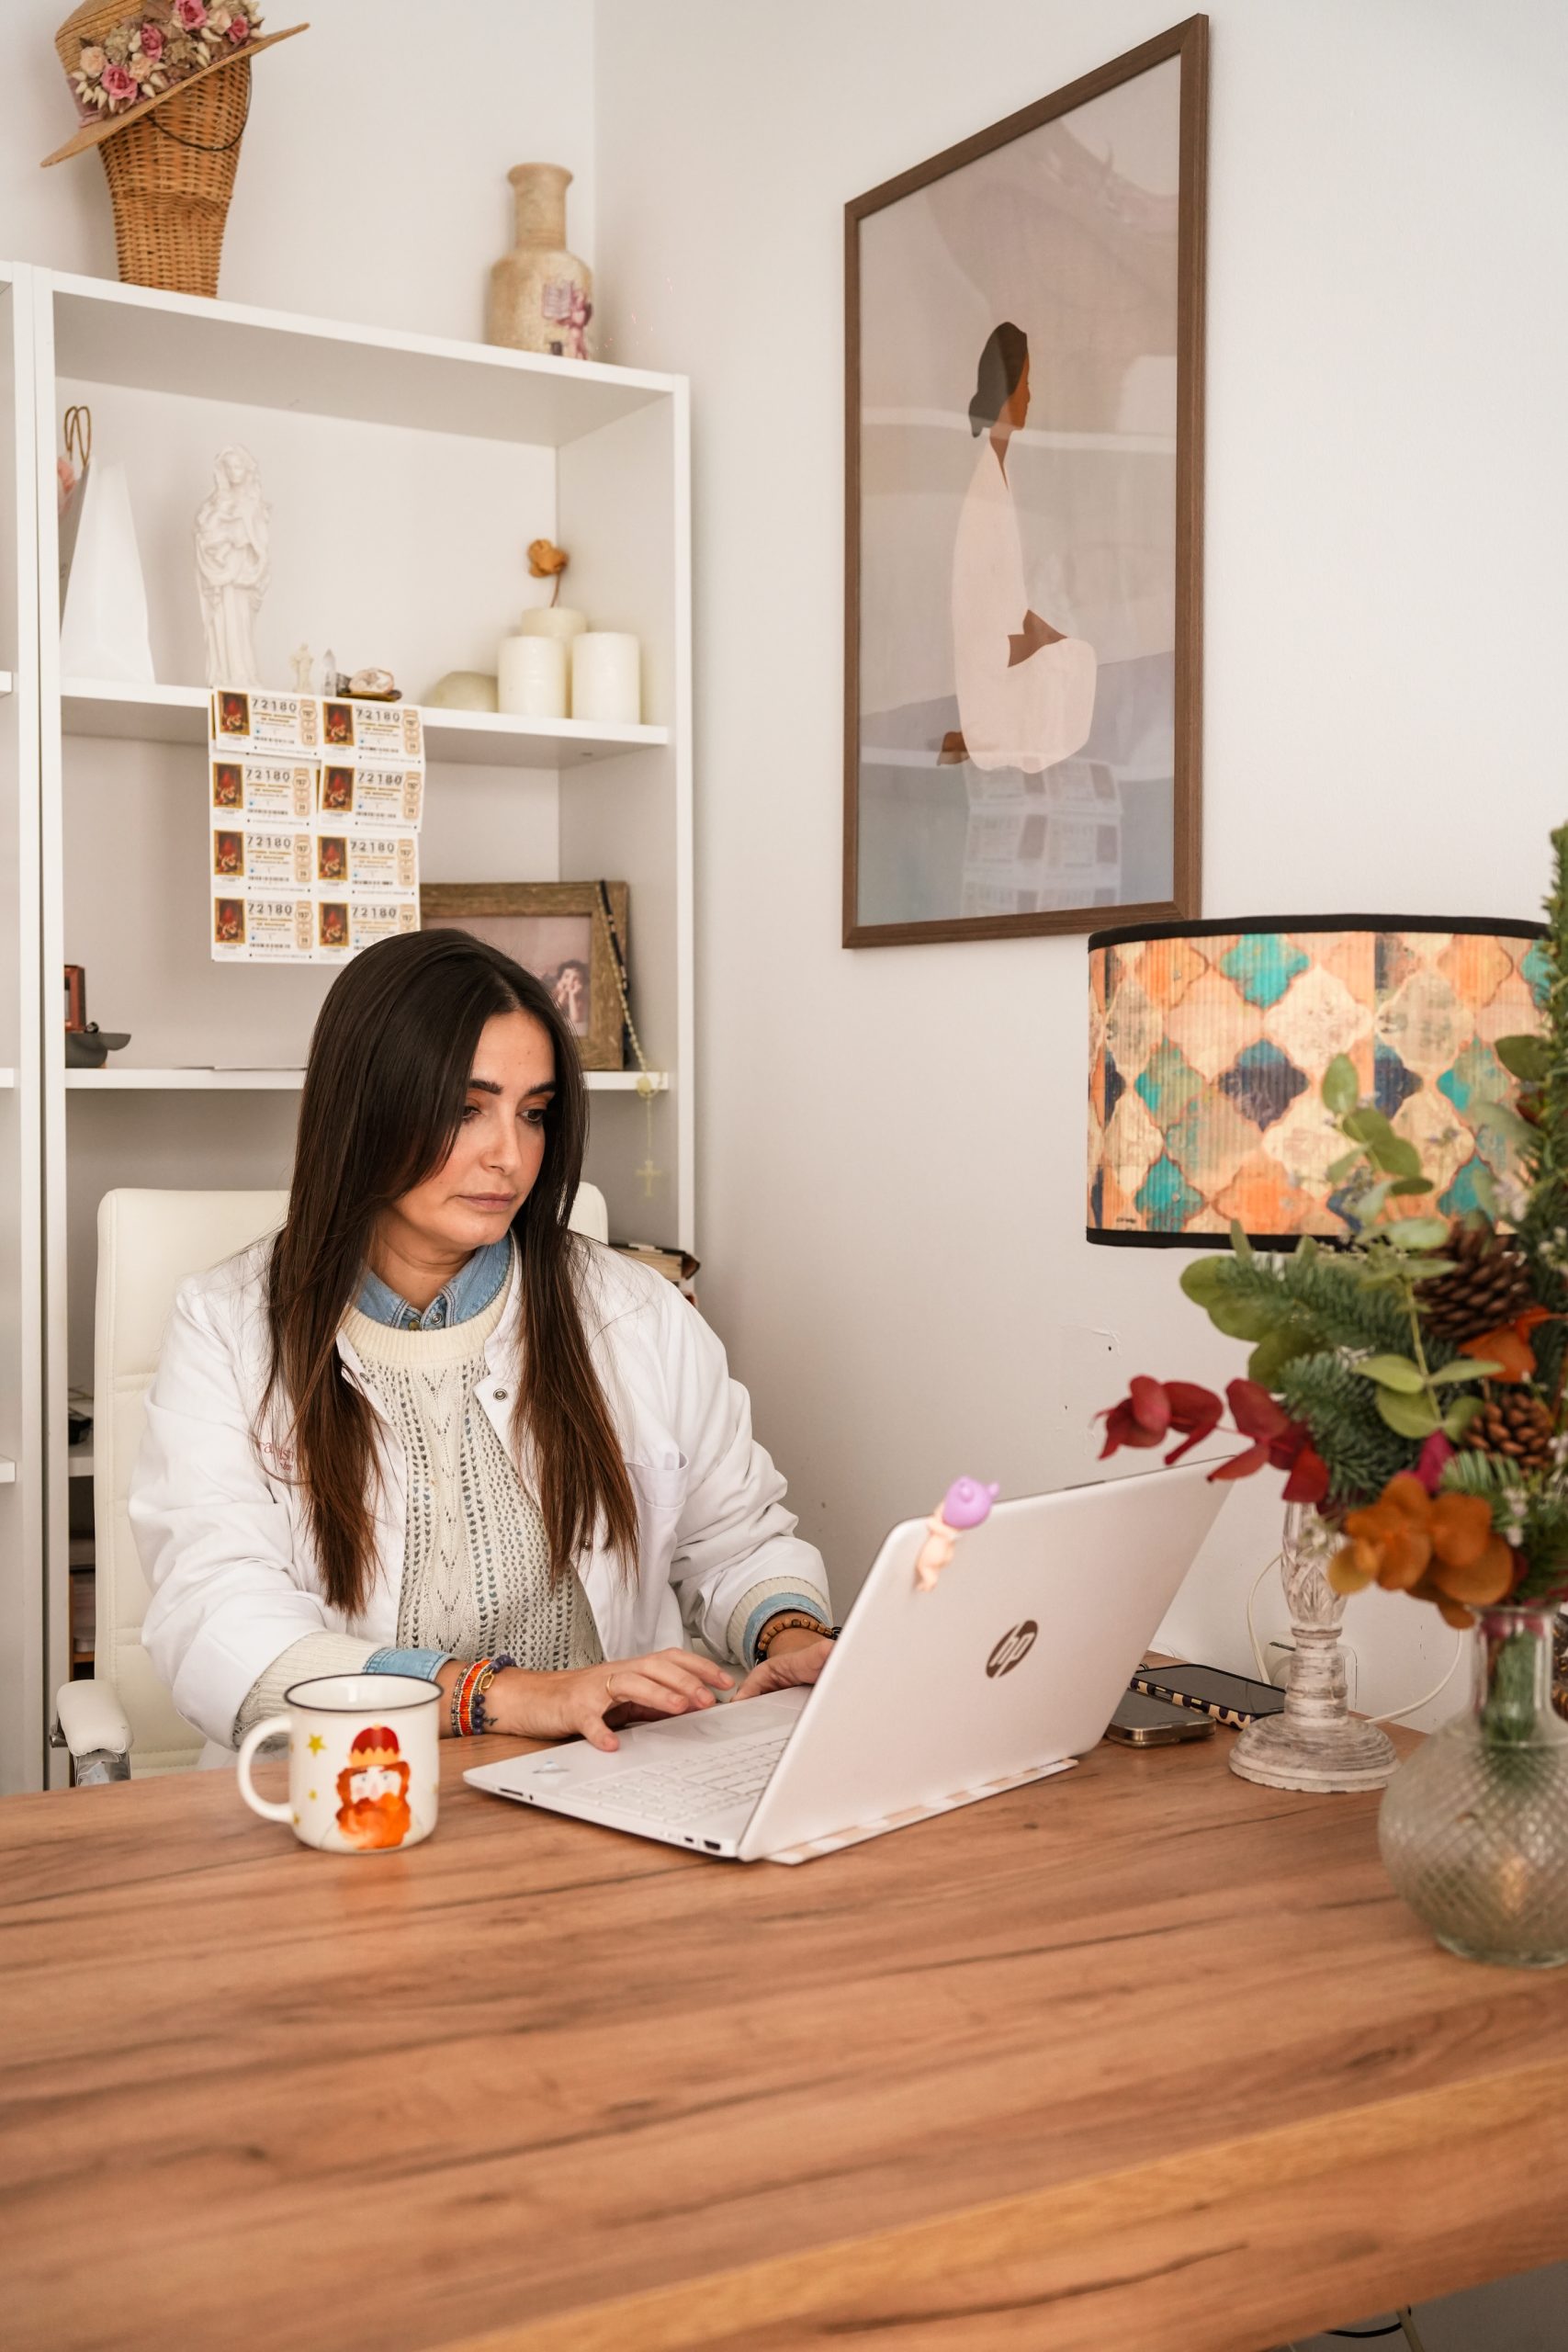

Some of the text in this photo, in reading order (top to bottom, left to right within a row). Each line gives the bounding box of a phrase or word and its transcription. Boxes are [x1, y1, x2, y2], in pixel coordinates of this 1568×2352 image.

[252, 697, 297, 713] 72180
[356, 708, 400, 722] 72180
[246, 769, 290, 782] 72180
[358, 772, 402, 786] 72180
[247, 836, 291, 849] 72180
[351, 841, 395, 854] 72180
[248, 902, 292, 915] 72180
[353, 906, 397, 918] 72180
[987, 1621, 1037, 1679] hp
